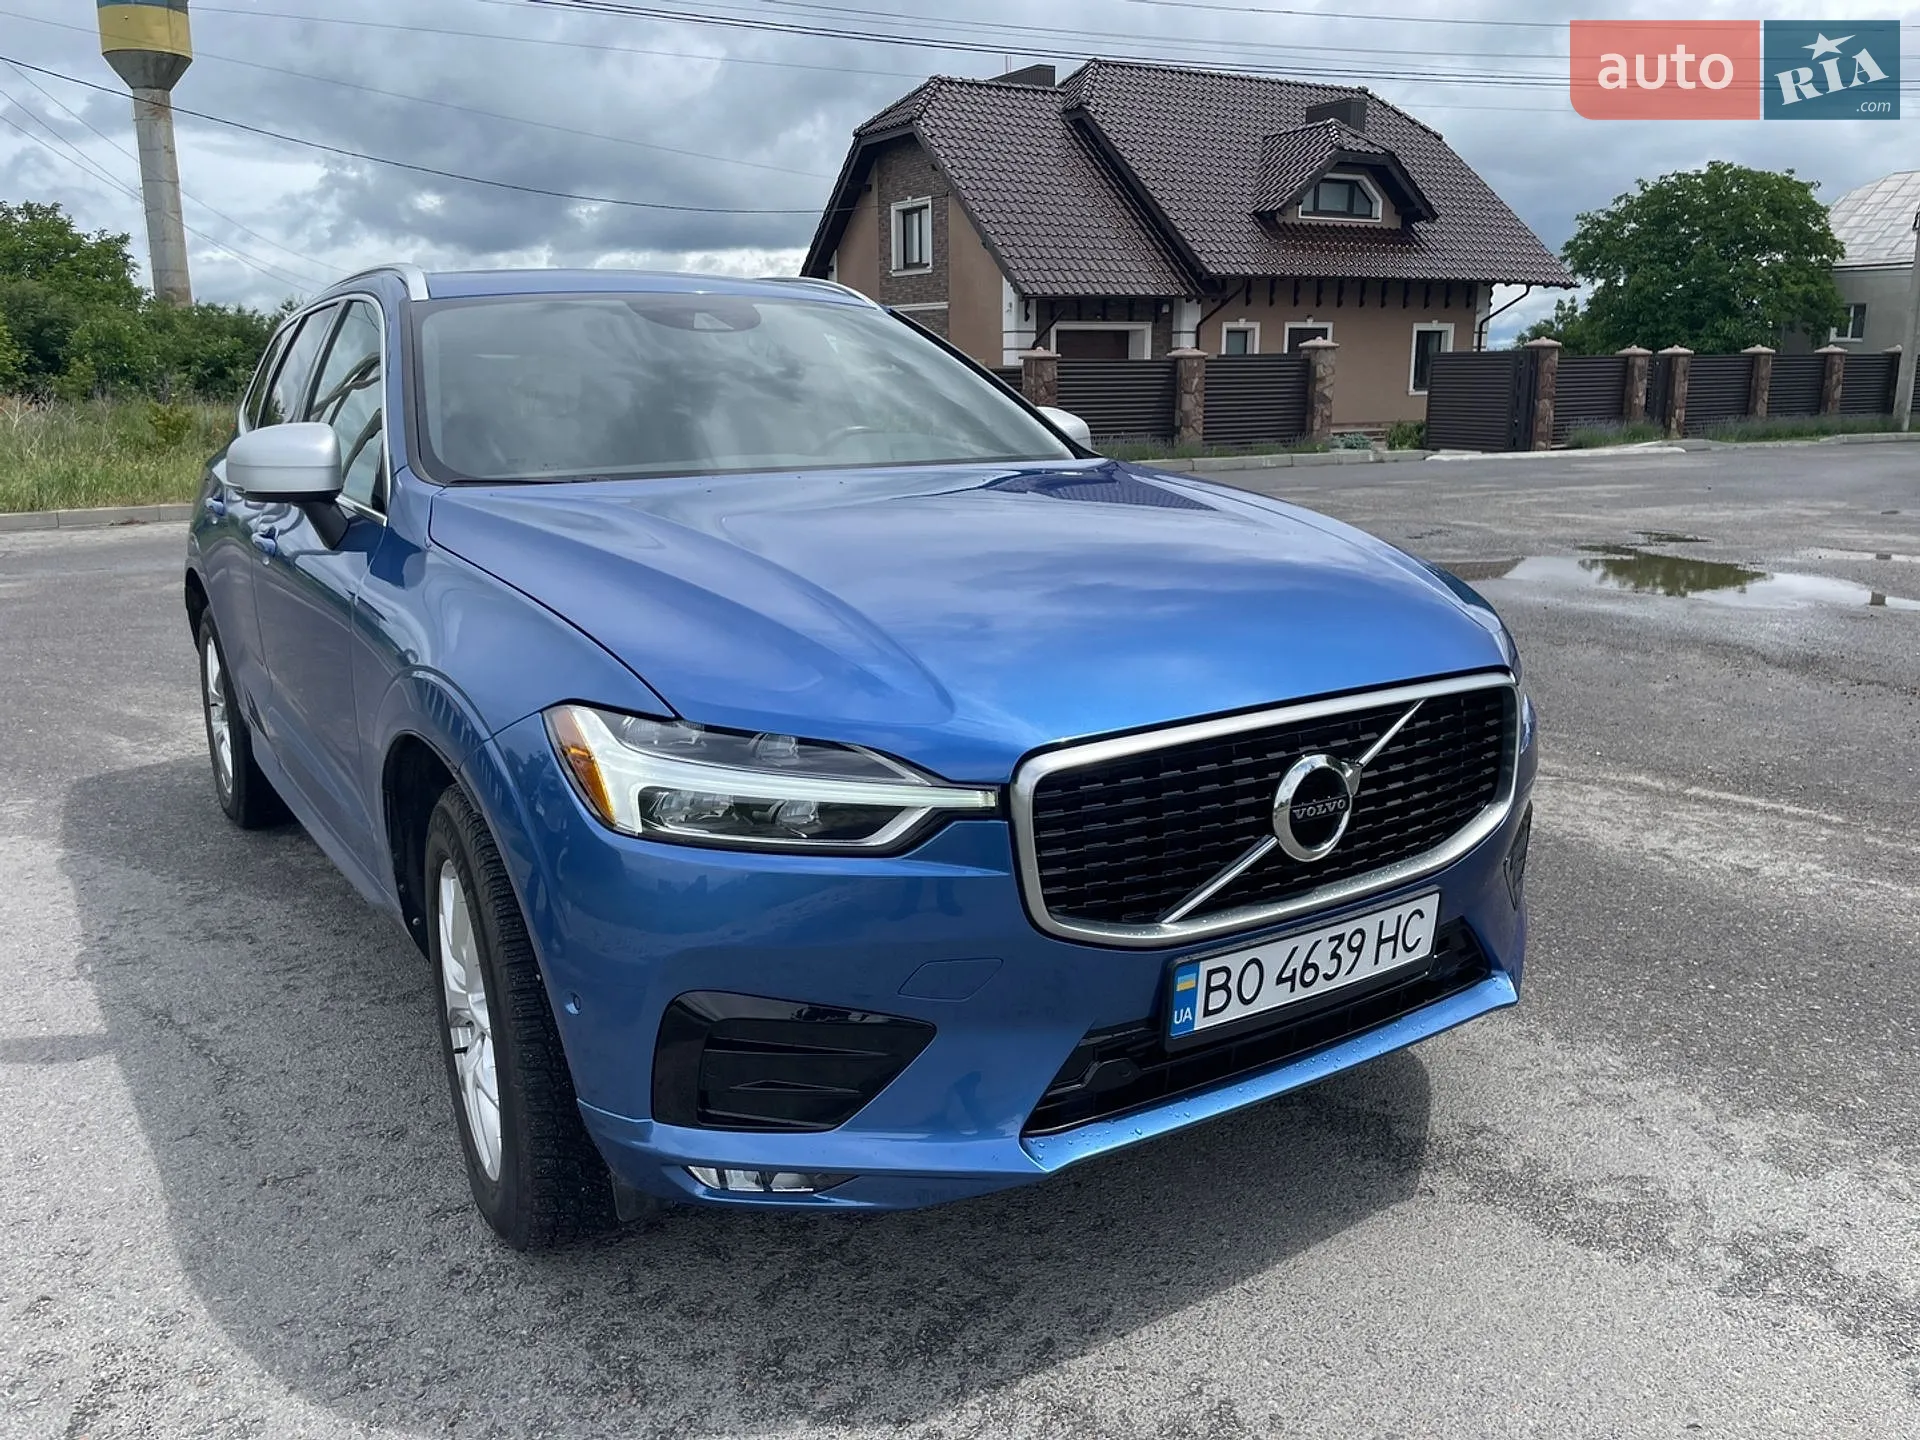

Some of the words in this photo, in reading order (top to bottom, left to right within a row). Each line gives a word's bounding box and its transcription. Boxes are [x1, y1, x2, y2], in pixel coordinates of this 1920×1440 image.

[1292, 799, 1346, 819] VOLVO
[1203, 957, 1264, 1018] BO
[1275, 927, 1367, 993] 4639
[1373, 908, 1425, 965] HC
[1174, 1007, 1192, 1025] UA
